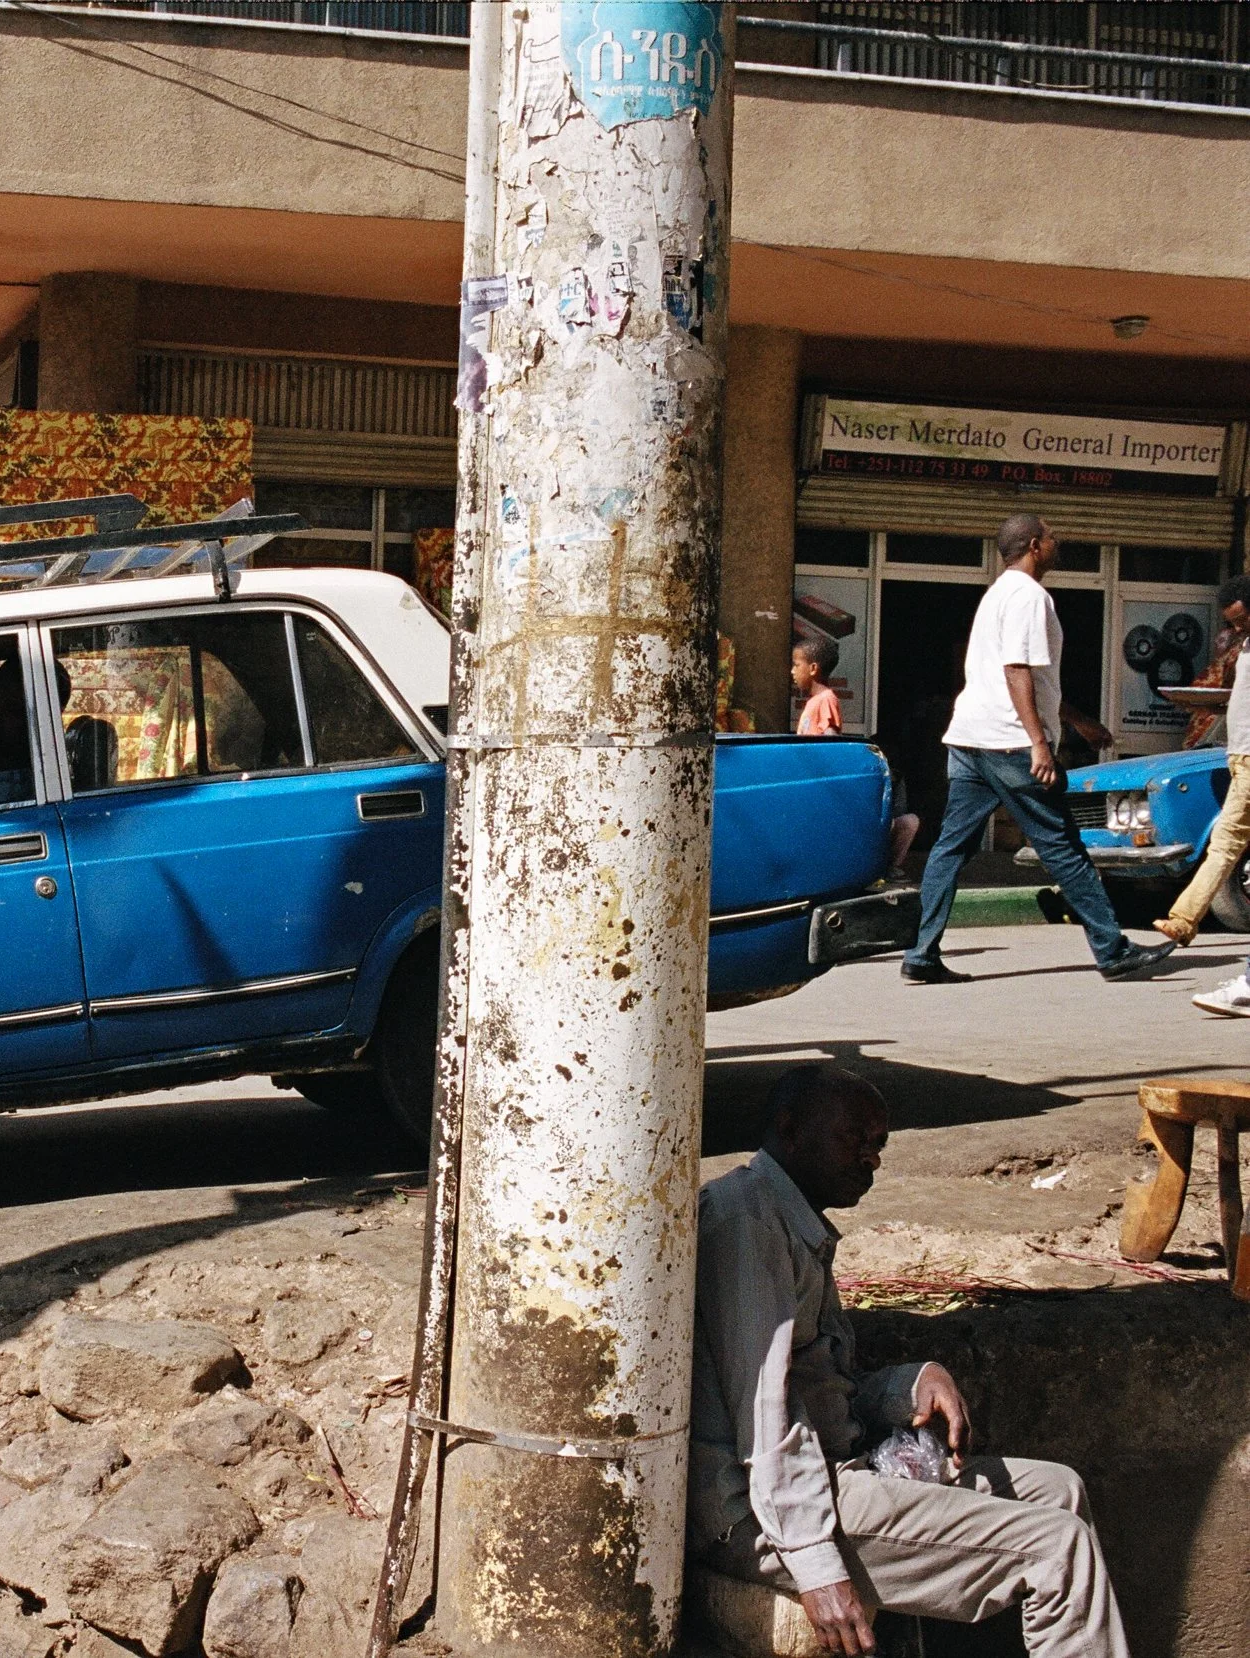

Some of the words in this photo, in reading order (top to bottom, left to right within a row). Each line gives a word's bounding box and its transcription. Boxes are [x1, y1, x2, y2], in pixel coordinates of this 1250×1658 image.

[830, 414, 900, 441] Naser
[907, 420, 1006, 449] Merdato
[1022, 427, 1114, 456] General
[1120, 434, 1222, 466] Importer
